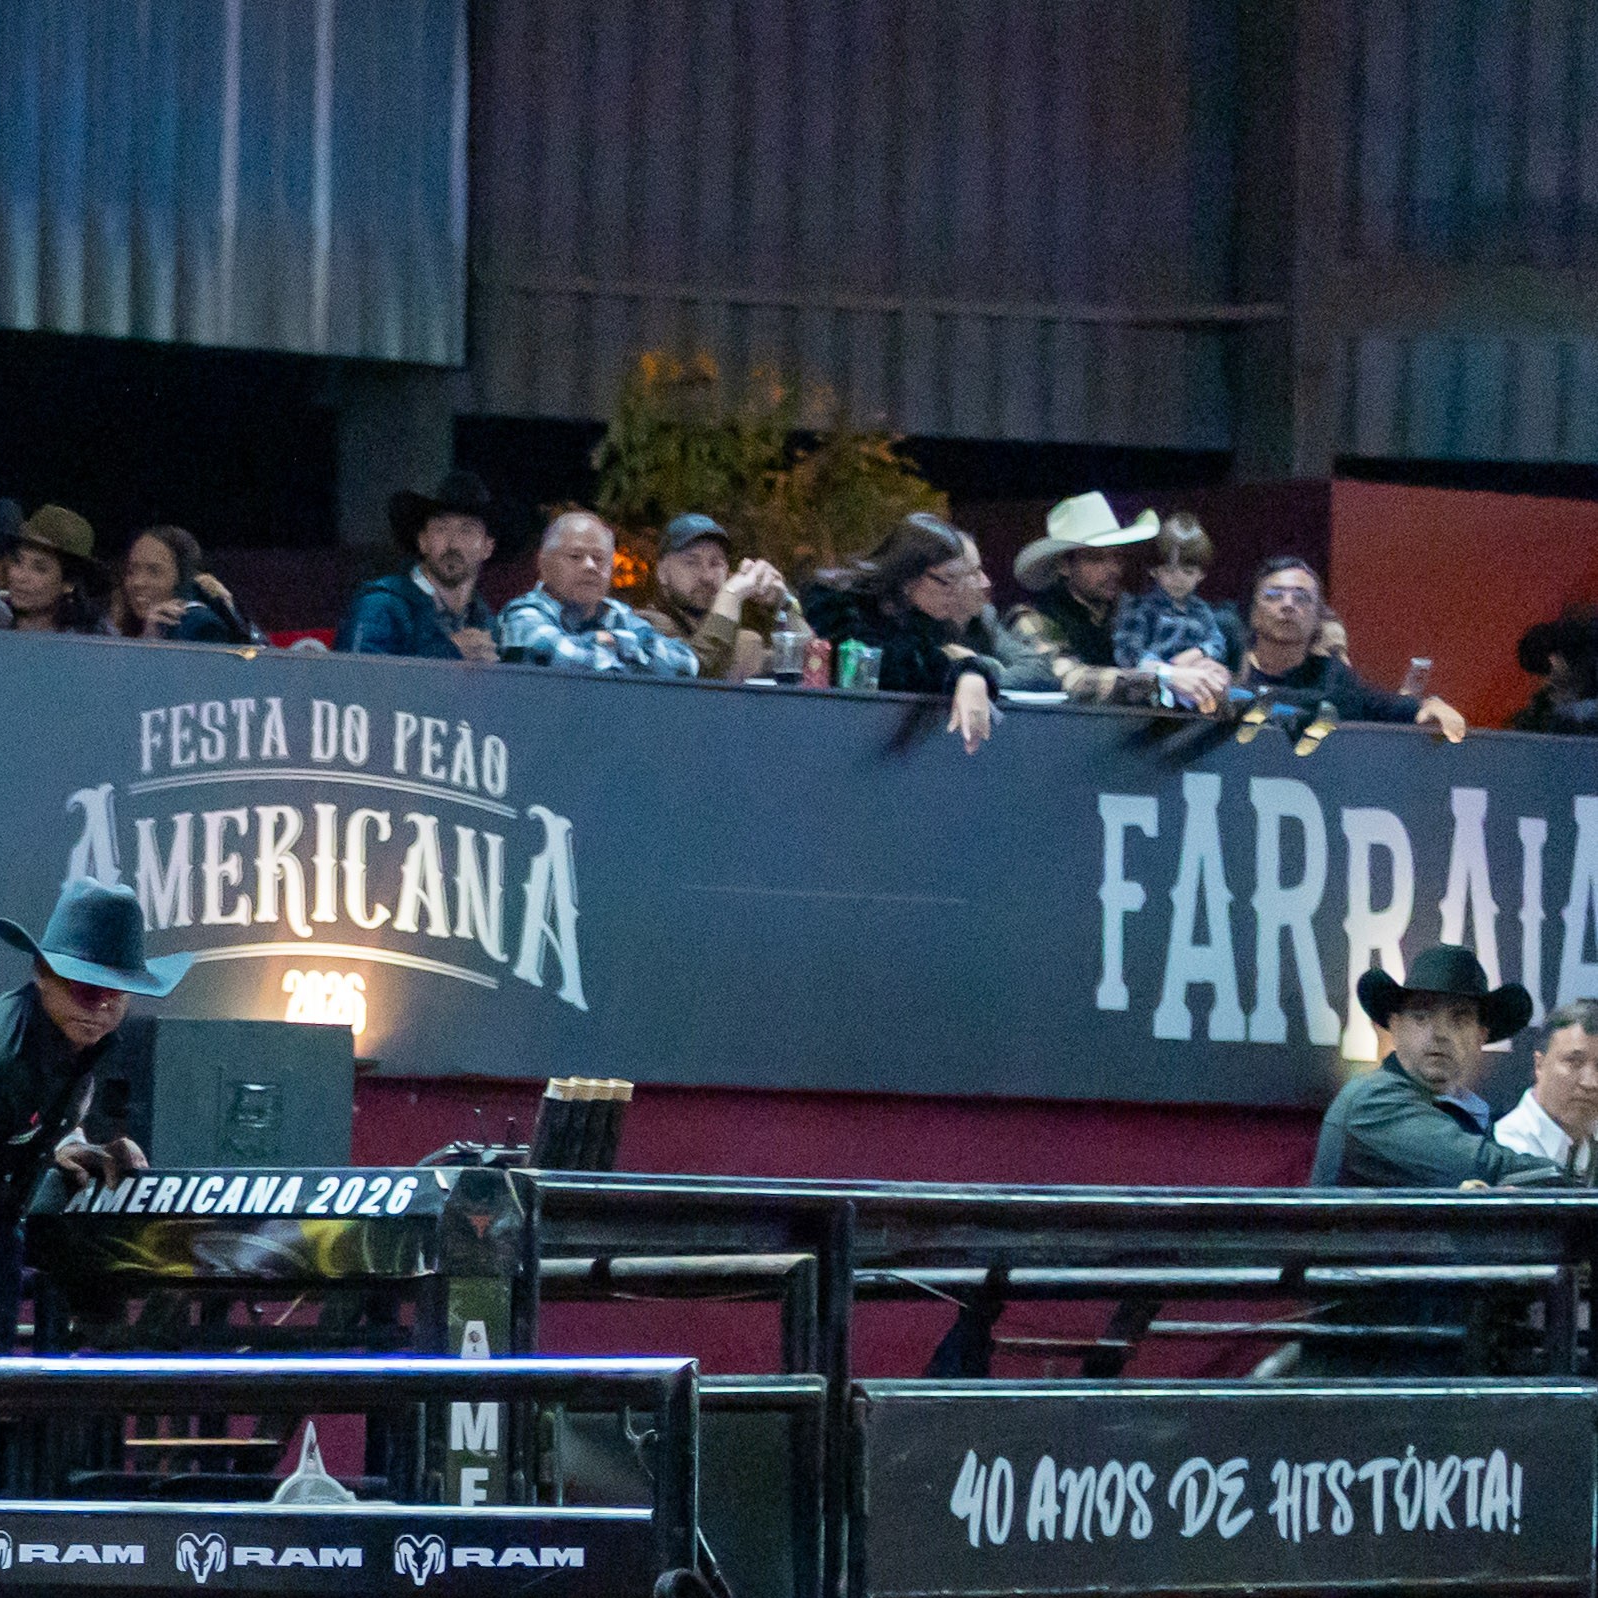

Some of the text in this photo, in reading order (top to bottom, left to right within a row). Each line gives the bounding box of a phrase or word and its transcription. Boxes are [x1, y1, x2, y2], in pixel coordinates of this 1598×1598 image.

[139, 697, 509, 798] FESTA DO PEÃO
[63, 782, 589, 1012] AMERICANA
[64, 1175, 419, 1215] AMERICANA 2026
[949, 1443, 1523, 1549] 40 ANOS DE HISTÓRIA!
[18, 1543, 145, 1566] RAM
[232, 1546, 363, 1568] RAM
[452, 1547, 586, 1568] RAM
